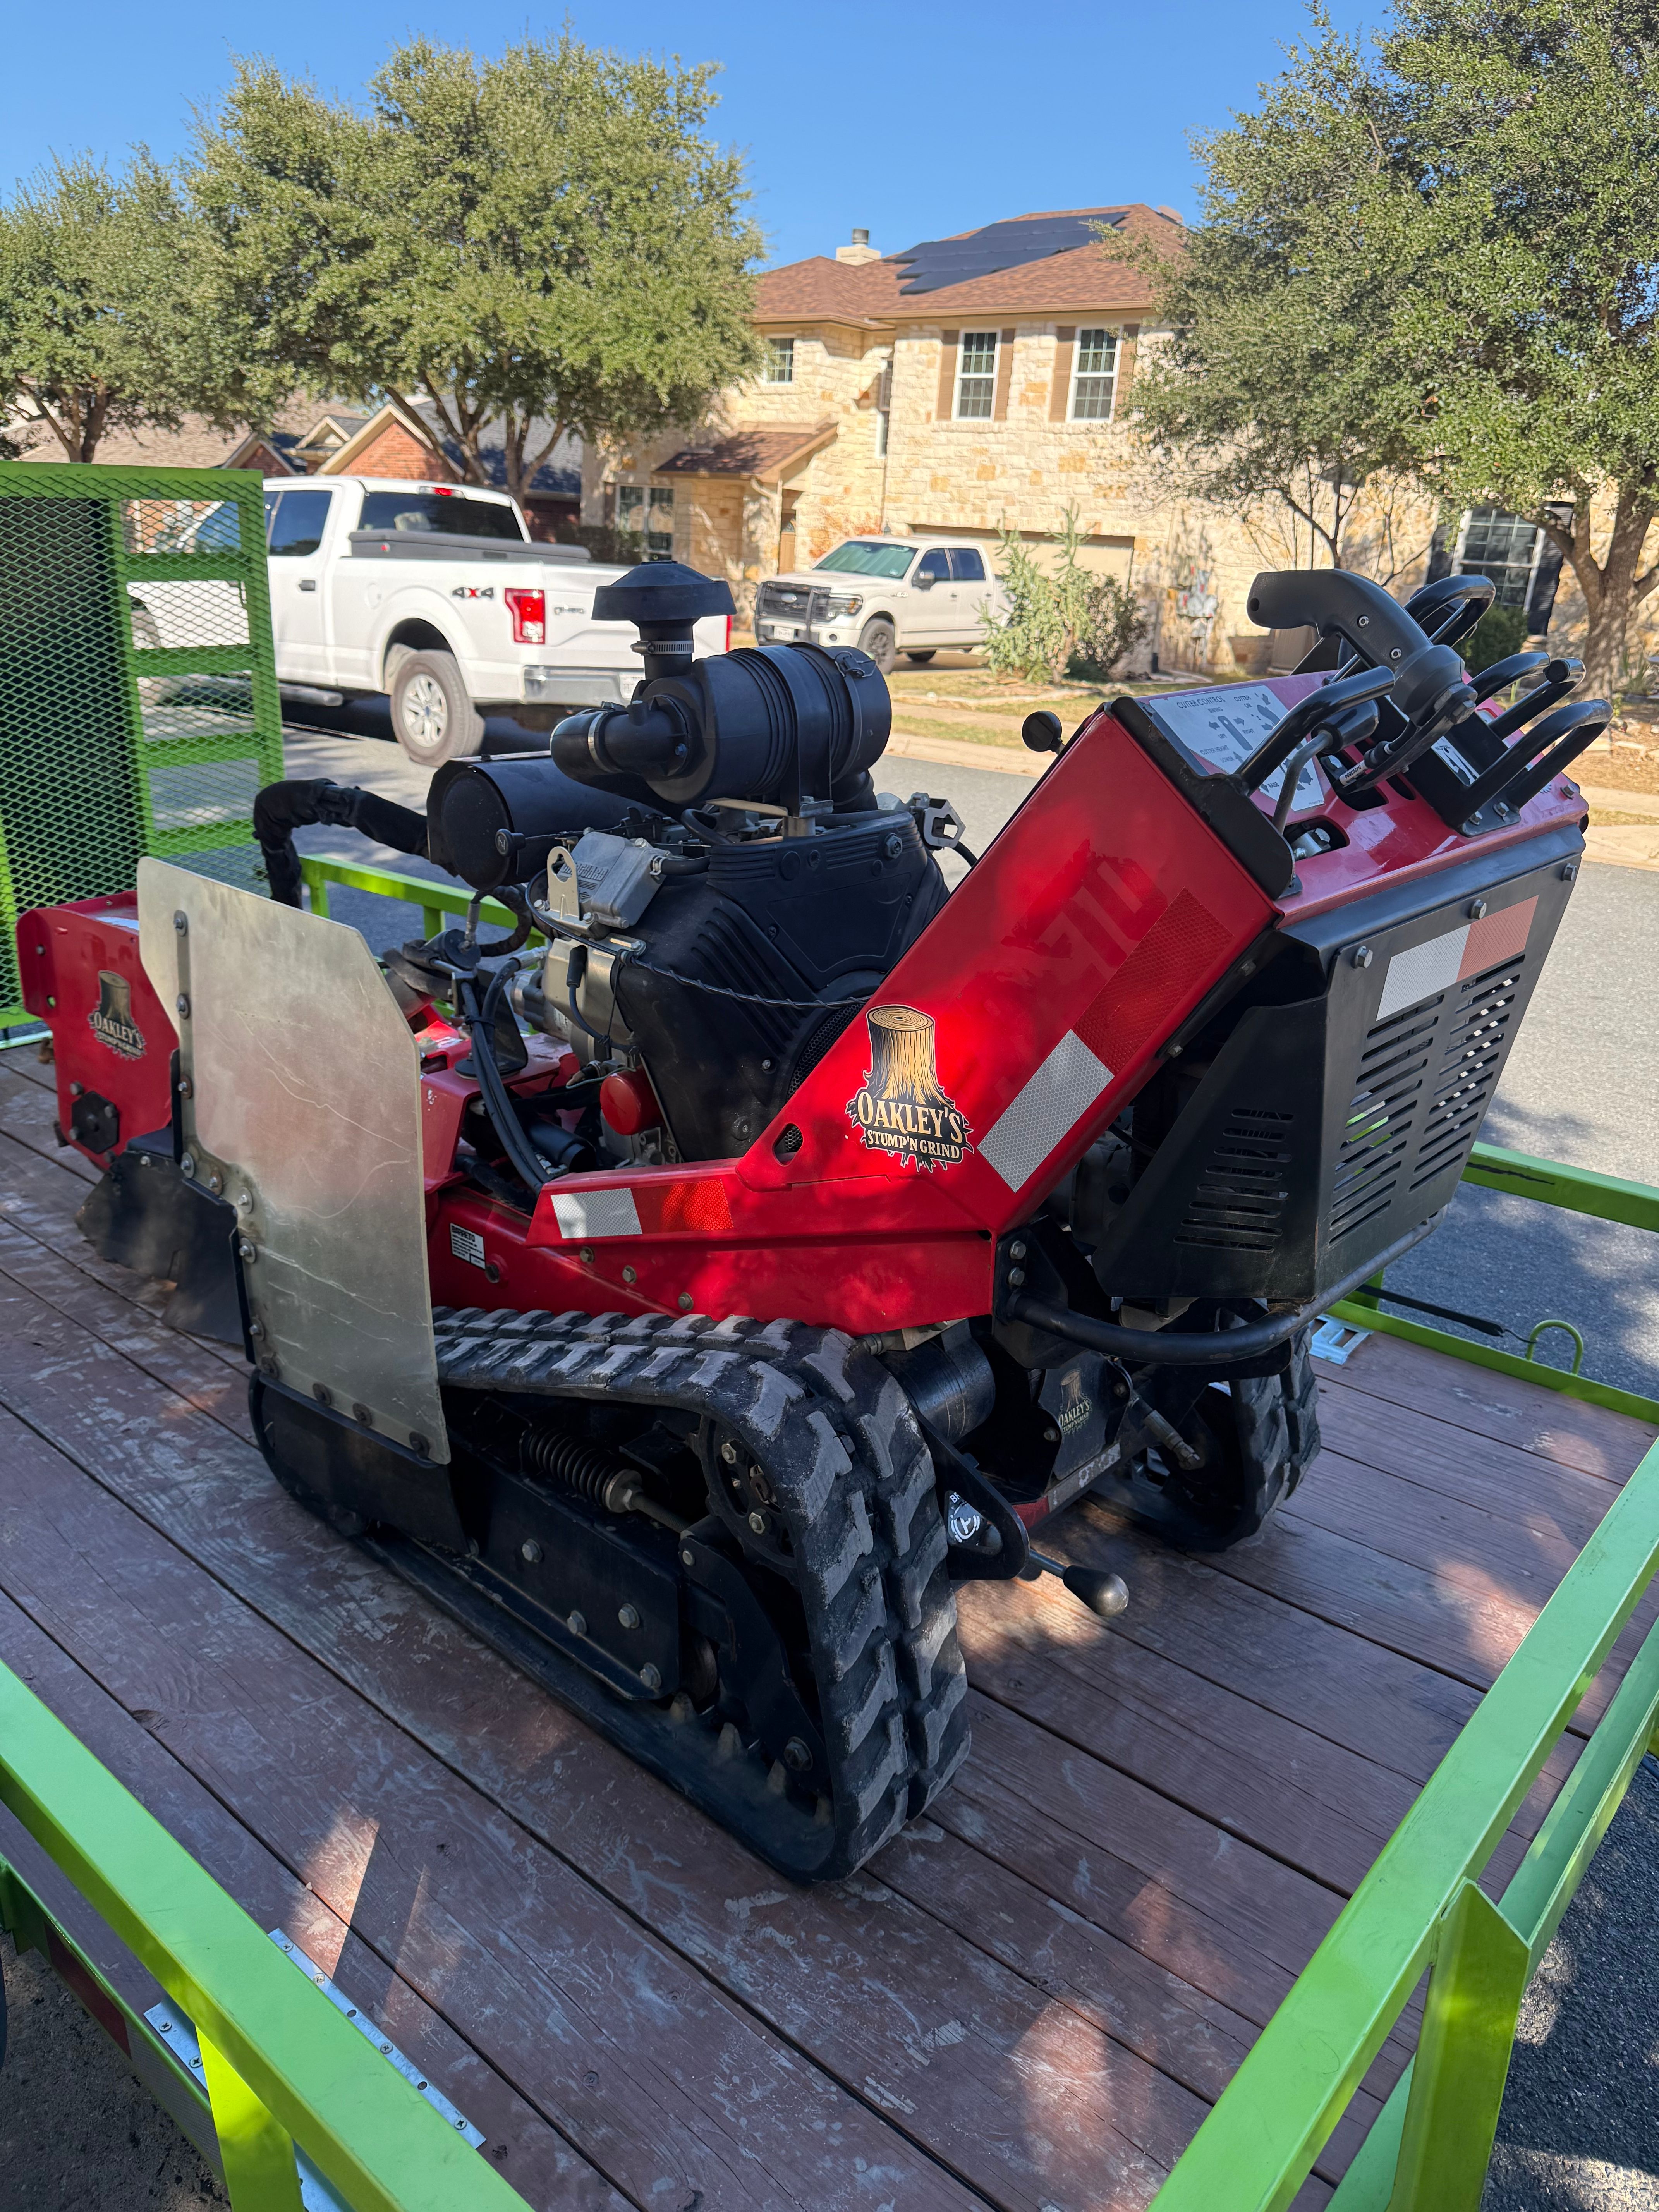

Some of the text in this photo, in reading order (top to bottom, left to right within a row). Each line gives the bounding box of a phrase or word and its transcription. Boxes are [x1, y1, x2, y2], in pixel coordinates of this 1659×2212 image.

[1176, 696, 1226, 709] CUTTER CONTROL
[94, 1011, 142, 1049] OAKLEY'S
[857, 1091, 963, 1144] OAKLEY'S
[867, 1130, 960, 1159] STUMP'N GRIND
[1058, 1400, 1090, 1427] OAKLEY'S
